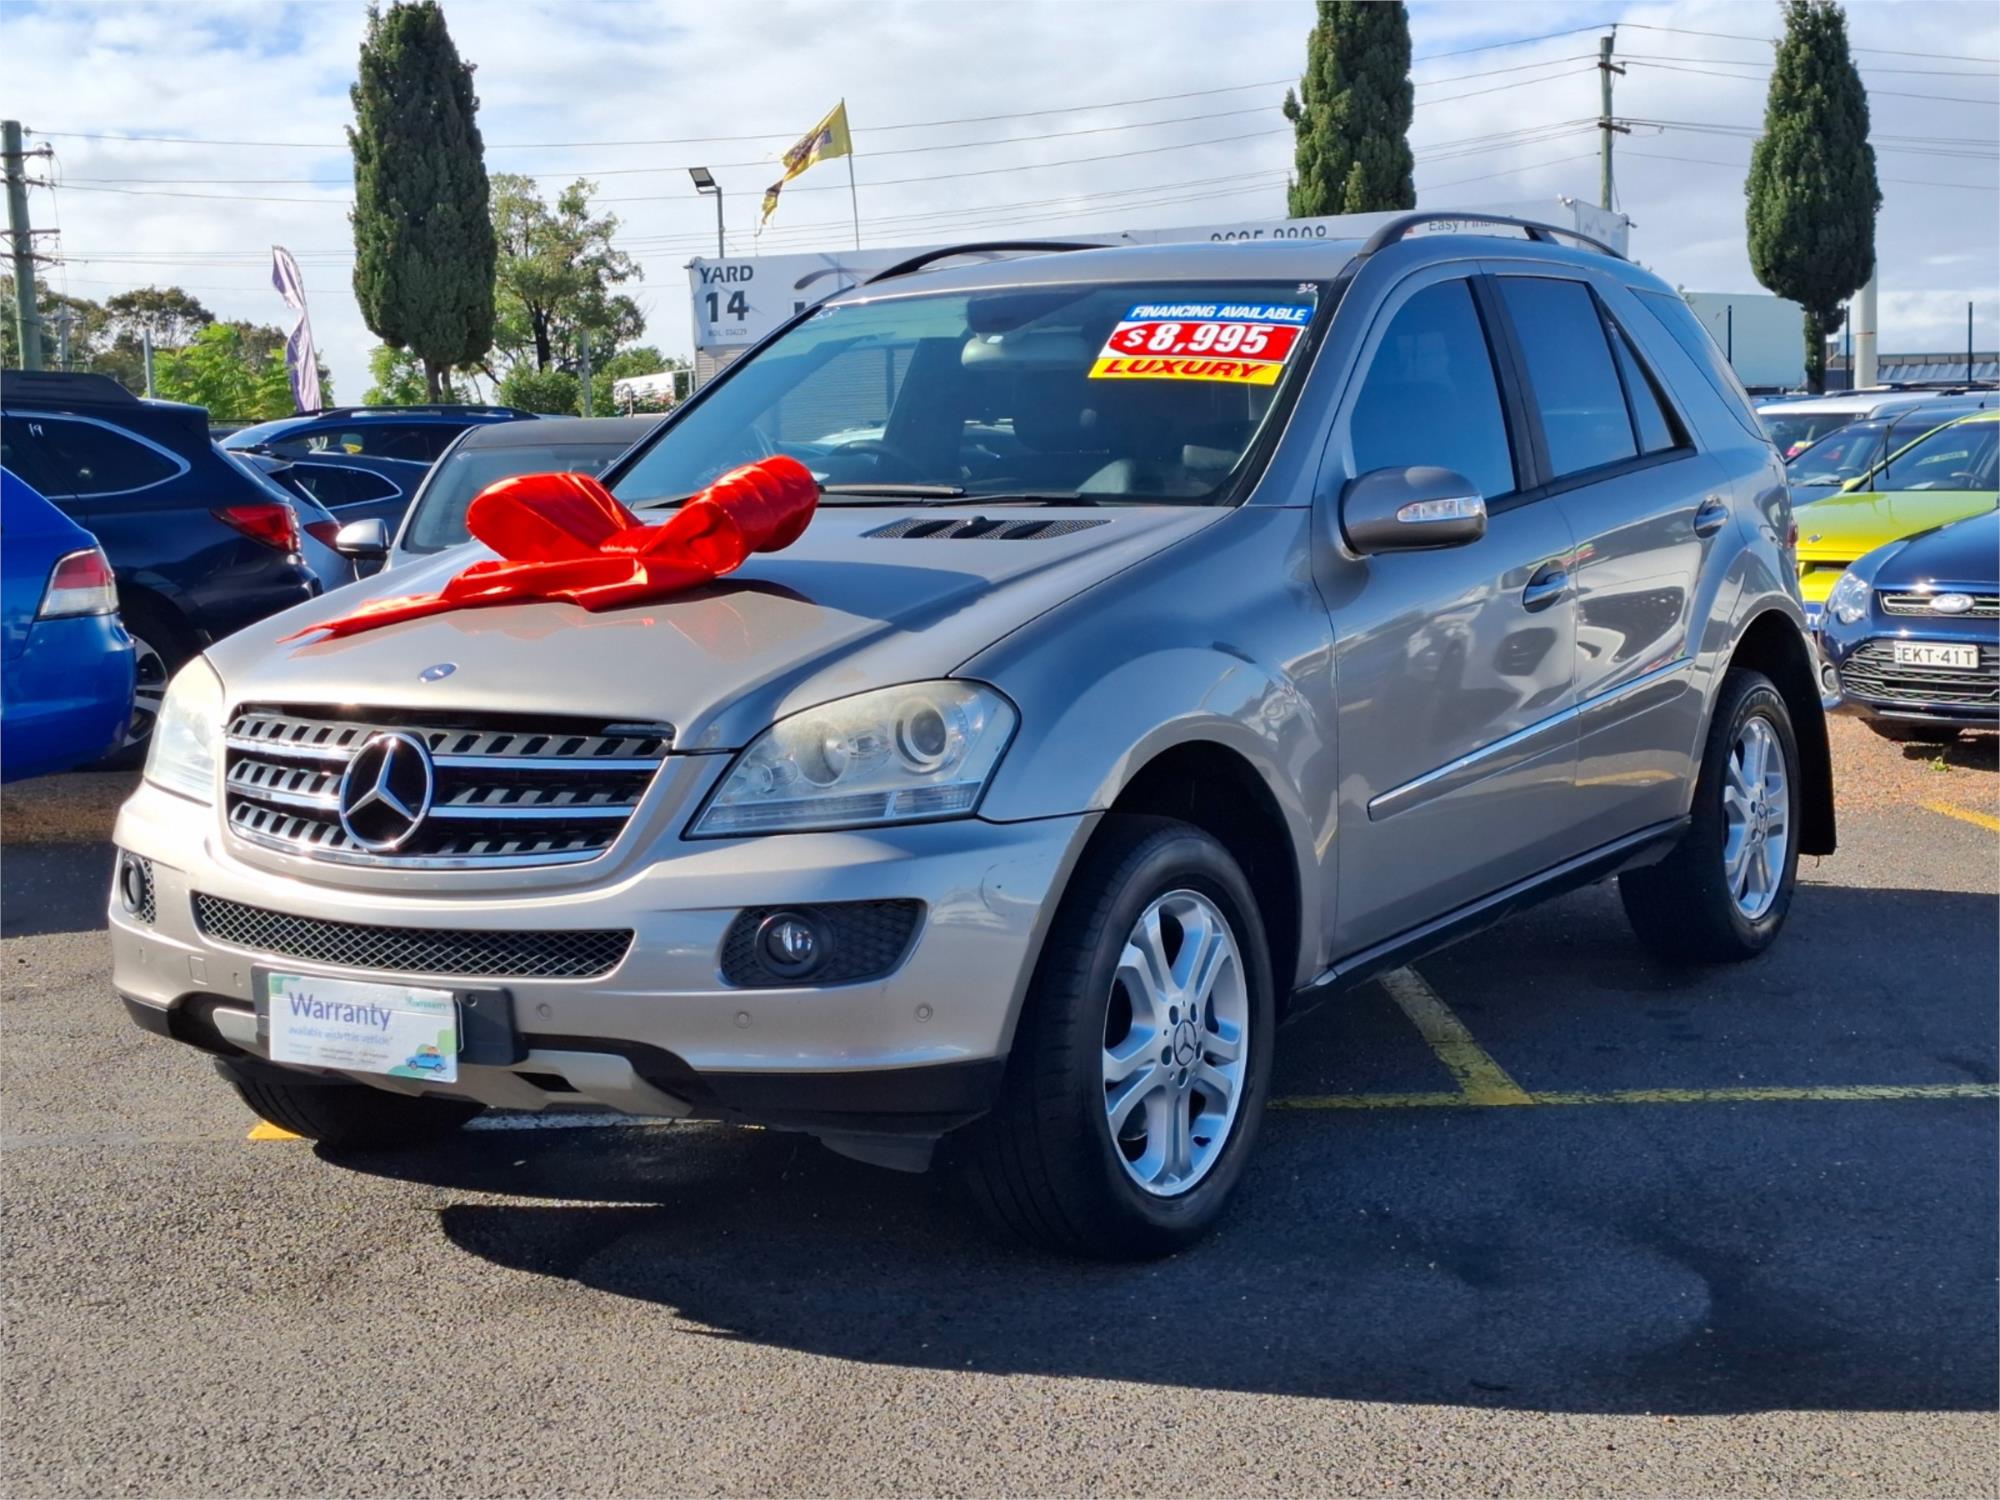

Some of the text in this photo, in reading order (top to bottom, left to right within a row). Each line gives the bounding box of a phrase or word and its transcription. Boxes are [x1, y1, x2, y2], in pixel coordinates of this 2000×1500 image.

[700, 265, 754, 284] YARD
[705, 291, 749, 323] 14
[1130, 304, 1308, 321] FINANCING AVAILABLE
[1103, 359, 1266, 378] LUXURY
[289, 991, 391, 1031] Warranty
